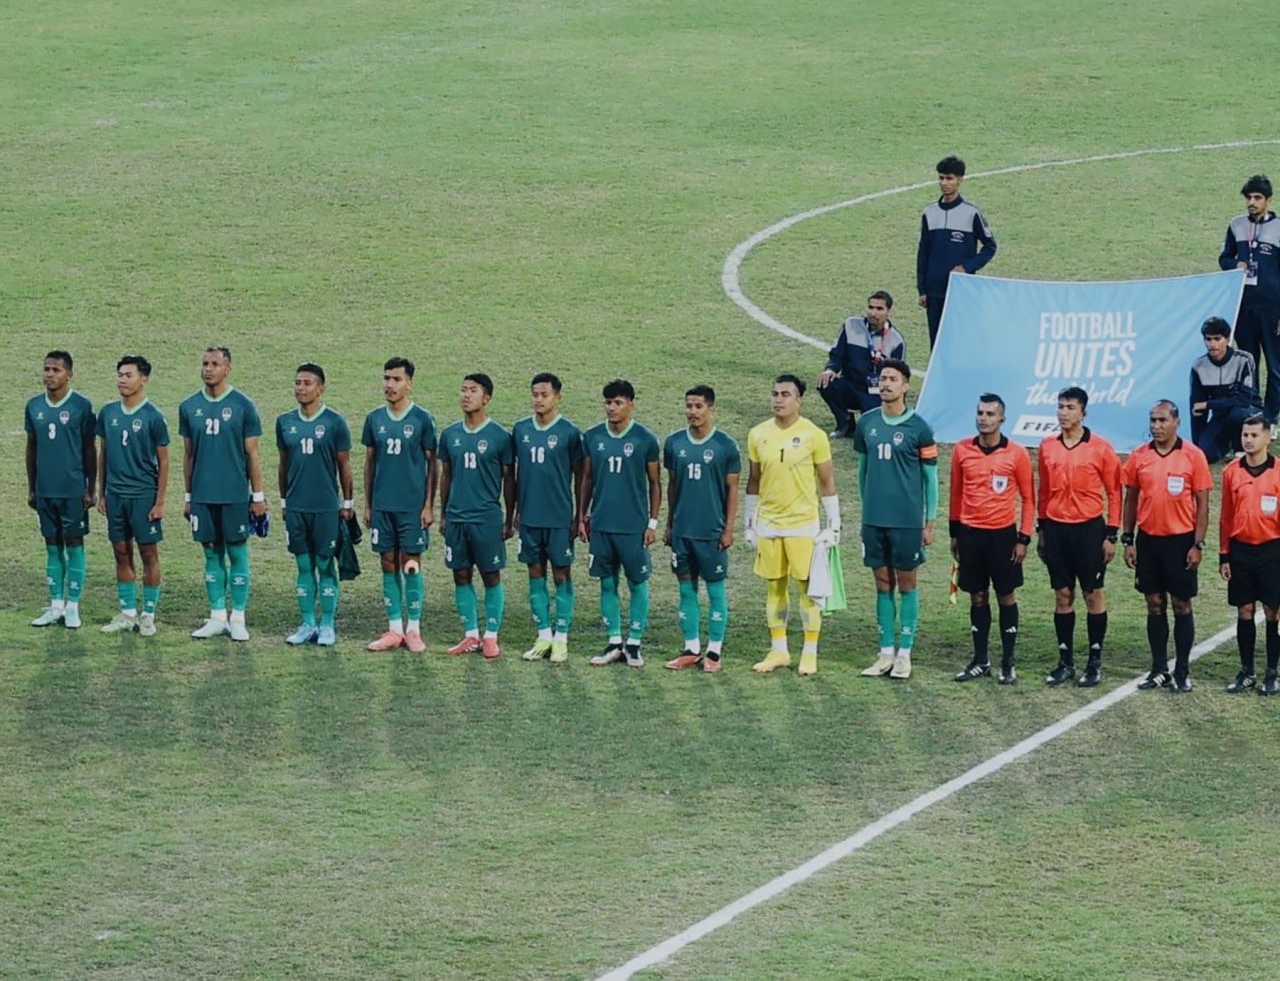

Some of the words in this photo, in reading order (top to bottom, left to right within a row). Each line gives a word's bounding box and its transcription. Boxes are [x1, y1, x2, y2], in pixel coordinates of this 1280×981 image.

[1039, 311, 1137, 340] FOOTBALL
[1034, 340, 1136, 378] UNITES
[48, 423, 56, 439] 3
[300, 438, 313, 454] 18
[530, 446, 545, 463] 16
[877, 443, 891, 460] 10
[464, 452, 476, 469] 13
[780, 448, 784, 463] 1
[608, 456, 622, 473] 17
[688, 463, 701, 480] 15
